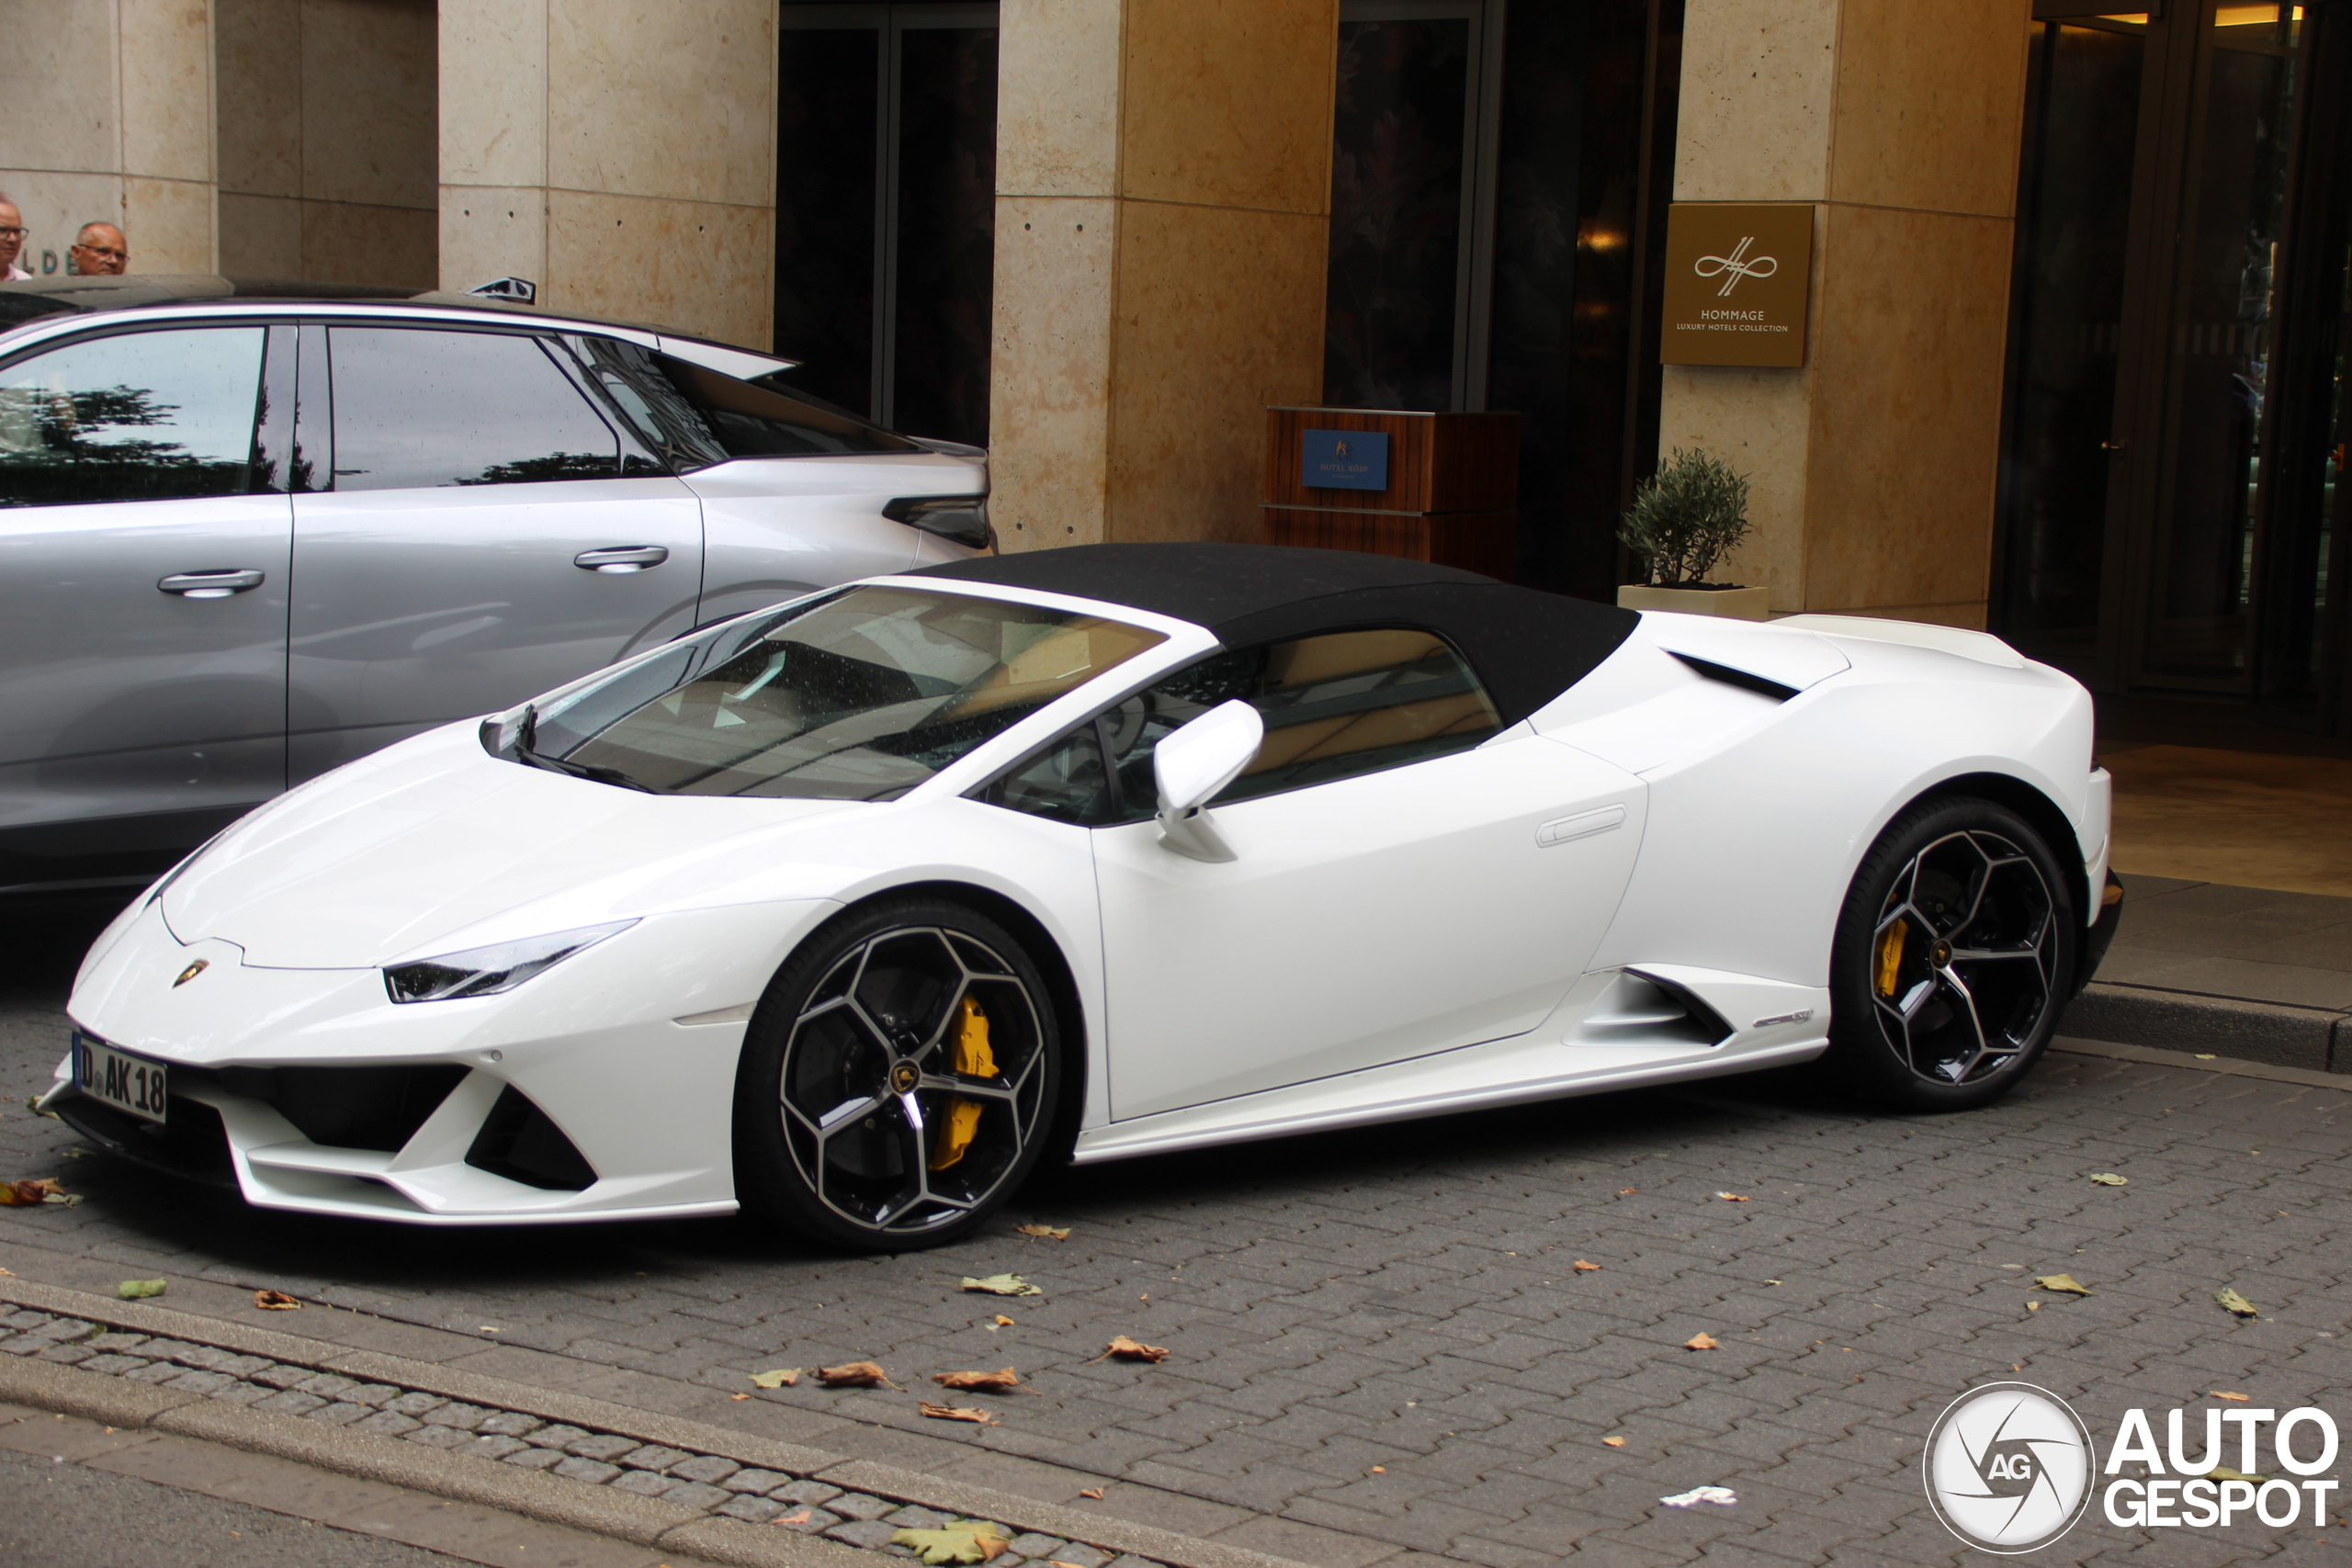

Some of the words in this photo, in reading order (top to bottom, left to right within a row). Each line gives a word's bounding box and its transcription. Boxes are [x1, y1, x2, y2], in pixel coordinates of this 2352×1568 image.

[1701, 310, 1765, 321] HOMMAGE
[1708, 323, 1737, 332] HOTELS
[1739, 324, 1789, 333] COLLECTION
[1319, 463, 1347, 472] HOTEL
[81, 1043, 93, 1089] D
[105, 1055, 131, 1105] AK
[135, 1064, 165, 1115] 18
